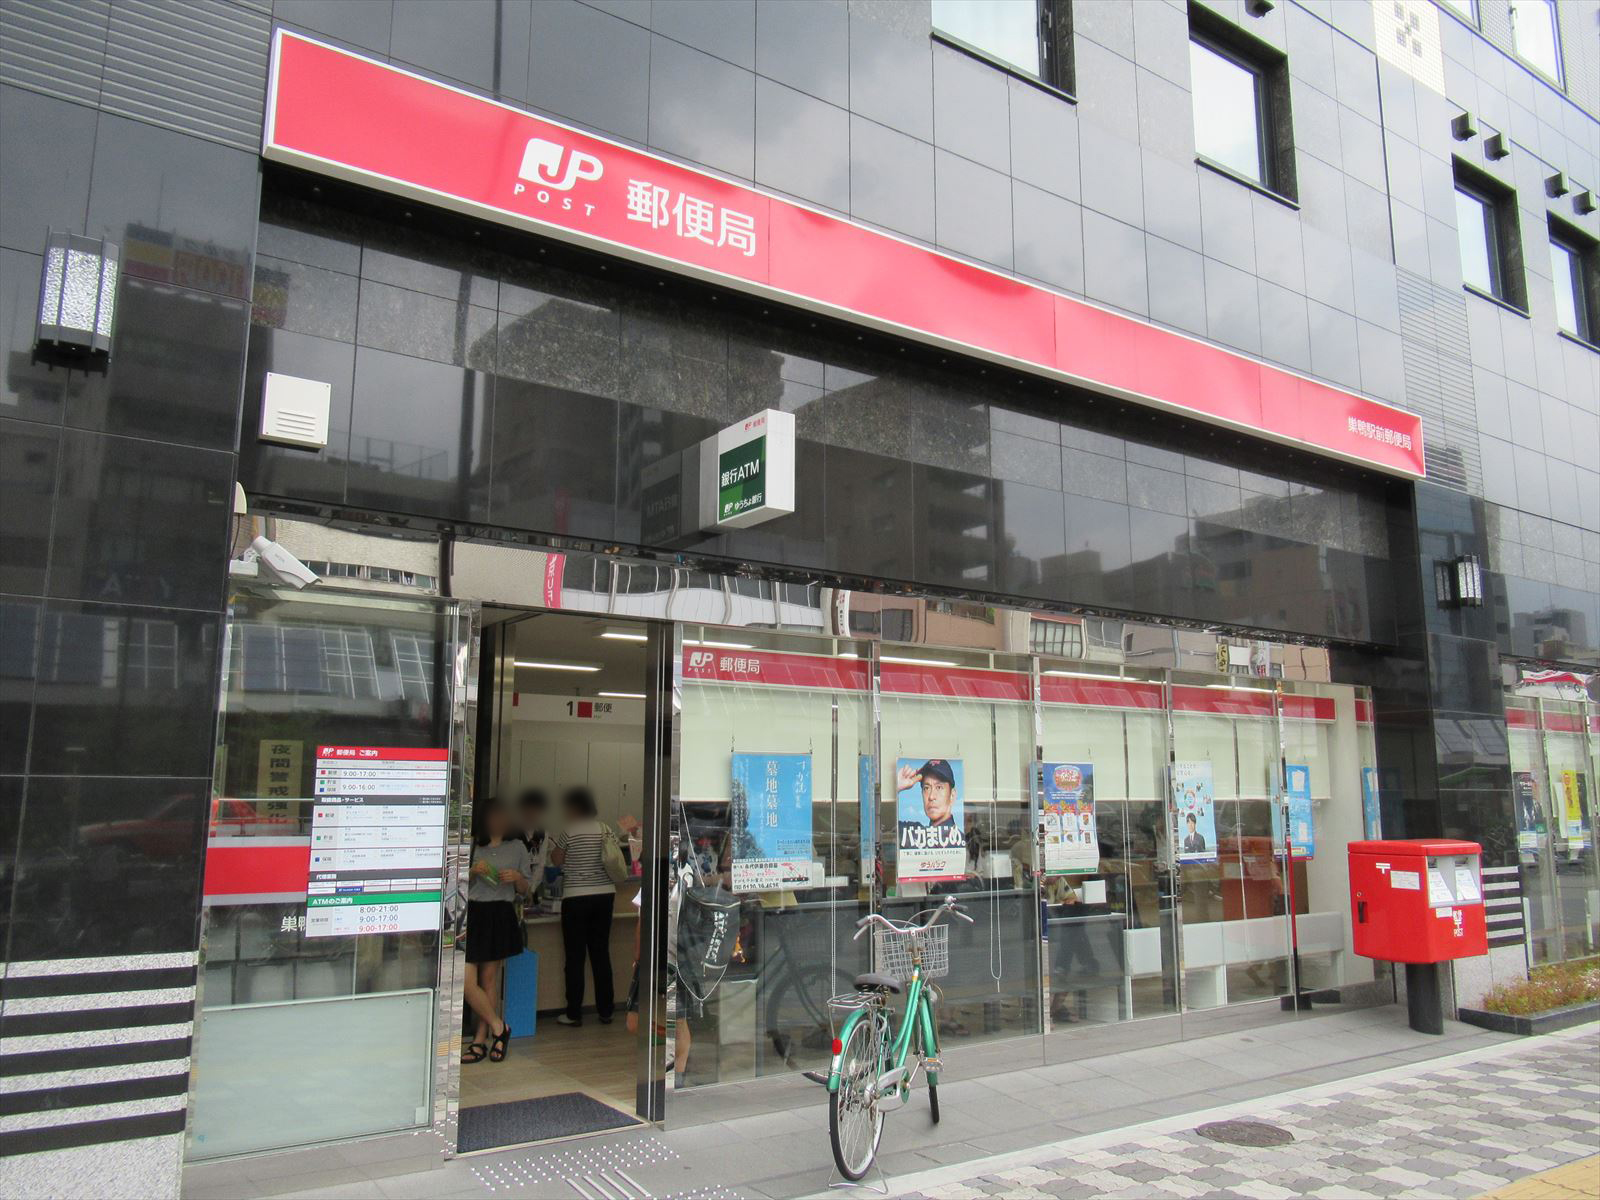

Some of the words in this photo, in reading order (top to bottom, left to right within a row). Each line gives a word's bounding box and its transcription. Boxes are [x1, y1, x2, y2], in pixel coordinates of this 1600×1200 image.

[518, 138, 604, 191] JP
[513, 183, 595, 217] POST
[626, 178, 756, 256] 郵便局
[721, 459, 759, 487] 銀行ATM
[735, 493, 762, 510] ゆうちょ銀行
[689, 652, 714, 667] JP
[719, 656, 760, 674] 郵便局
[566, 701, 573, 716] 1
[594, 702, 612, 713] 郵便
[766, 761, 778, 828] 墓地墓地
[901, 826, 966, 849] バカまじめ。
[312, 897, 353, 905] ATMのご案内
[359, 905, 399, 914] 8:00-21:00
[358, 923, 398, 932] 9:00-17:00
[359, 914, 398, 923] 9:00-17:00
